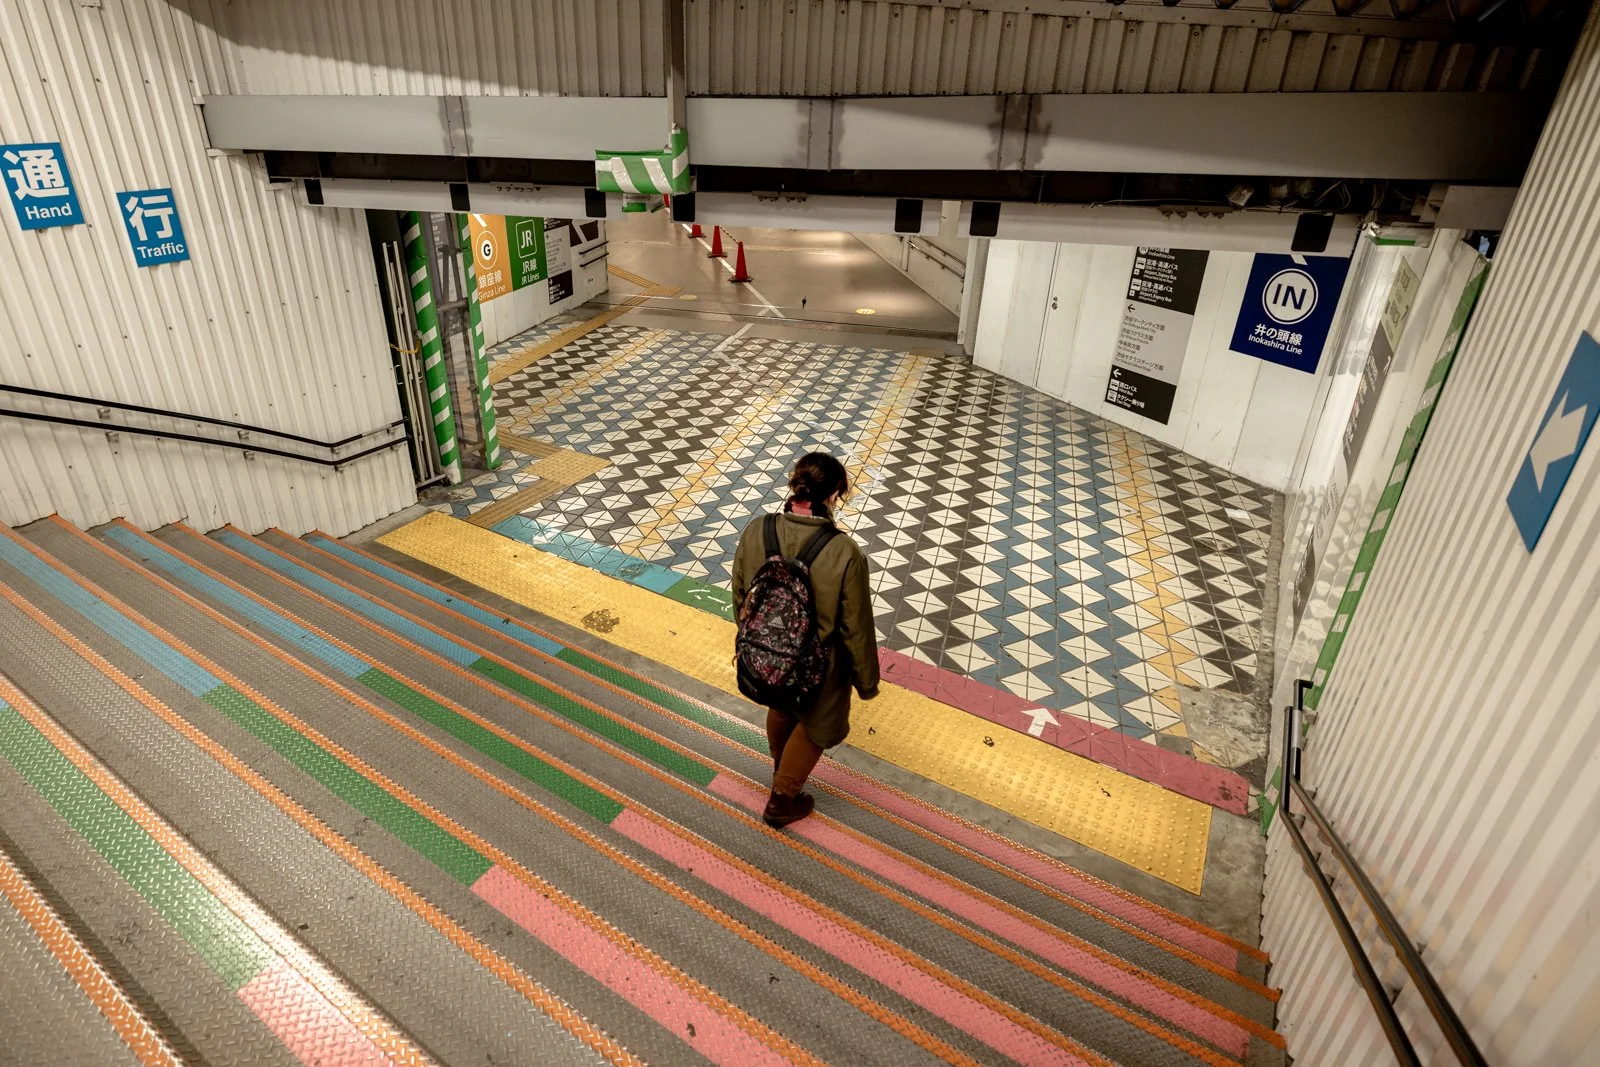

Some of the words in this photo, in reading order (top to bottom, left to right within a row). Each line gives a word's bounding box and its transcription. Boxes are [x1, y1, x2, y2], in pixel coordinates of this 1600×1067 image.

[3, 149, 69, 200] 通
[24, 202, 73, 220] Hand
[125, 195, 174, 241] 行
[520, 229, 533, 249] JR
[136, 242, 184, 259] Traffic
[483, 244, 492, 256] G
[522, 258, 538, 275] JR線
[478, 270, 503, 289] 銀座線
[521, 276, 528, 286] JR
[528, 272, 540, 283] Lines
[478, 287, 494, 301] Ginza
[495, 284, 506, 296] Line
[1273, 284, 1307, 310] IN
[1254, 323, 1303, 346] 井の頭線
[1248, 334, 1285, 350] Inokashira
[1286, 343, 1303, 355] Line
